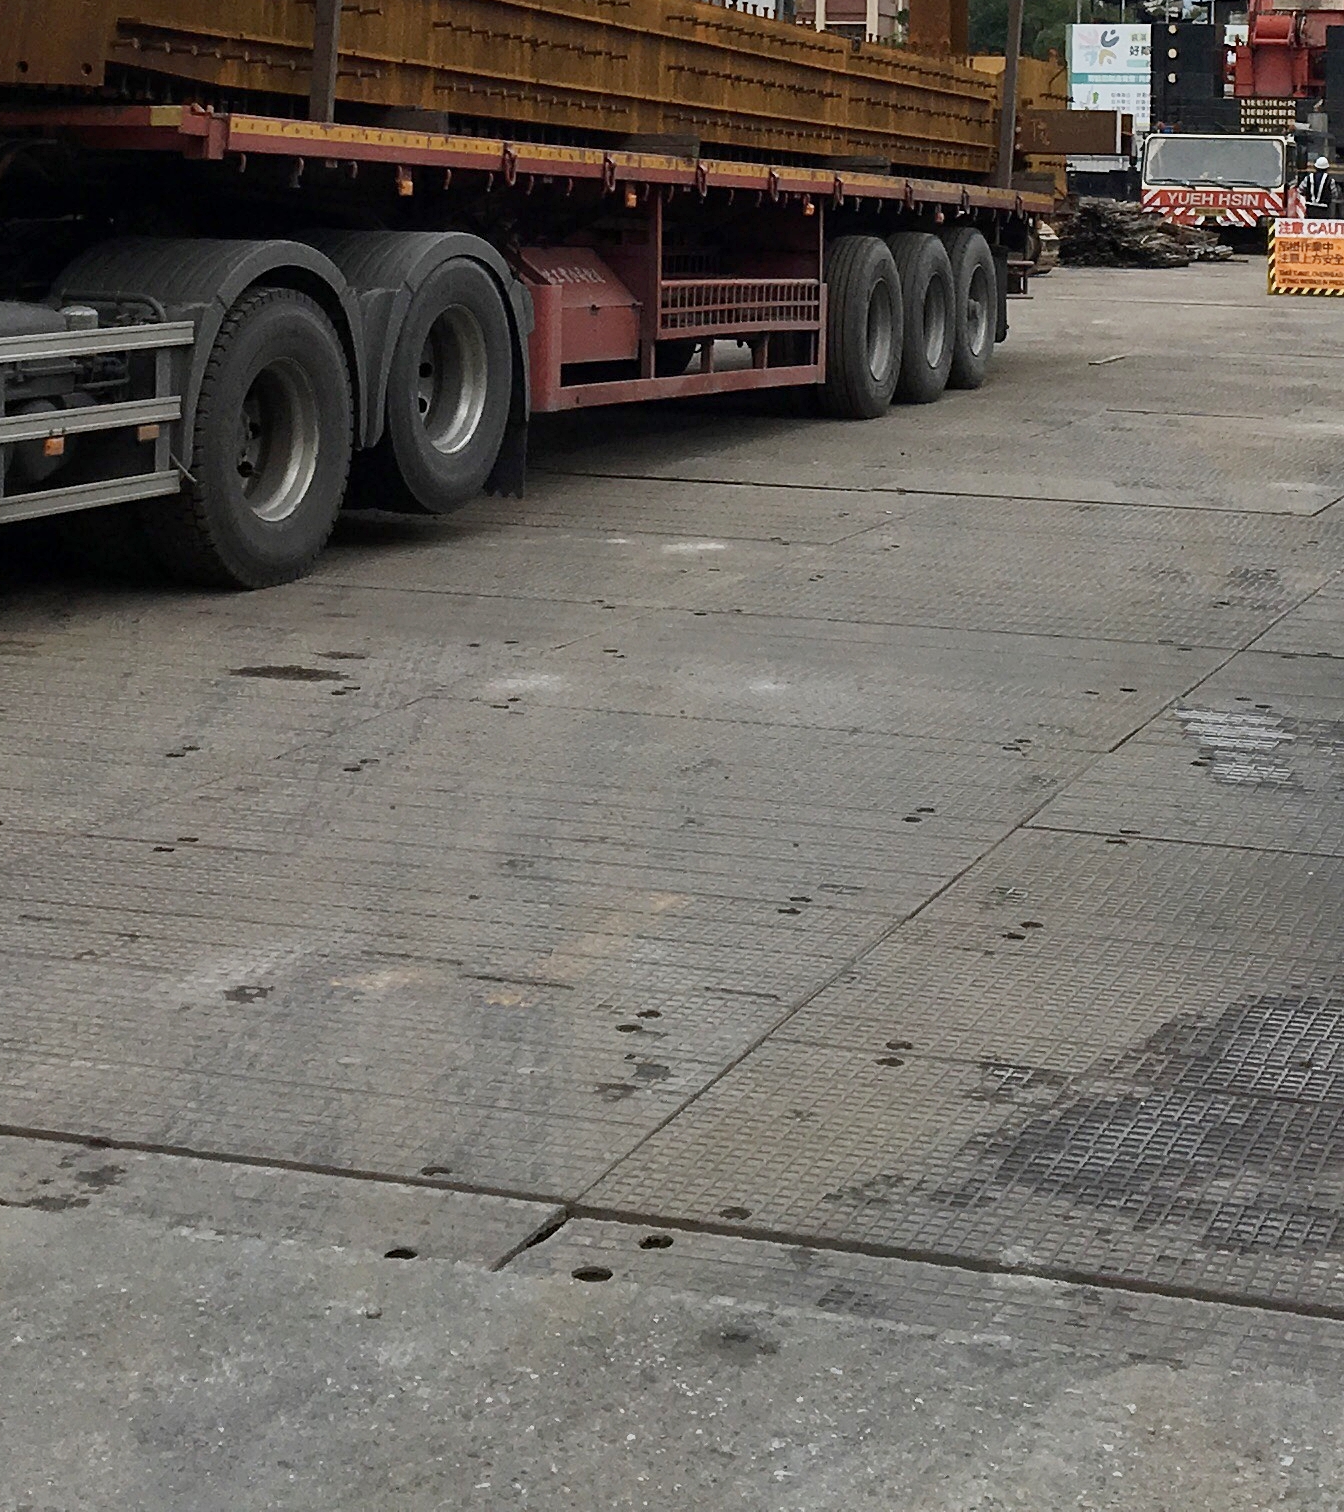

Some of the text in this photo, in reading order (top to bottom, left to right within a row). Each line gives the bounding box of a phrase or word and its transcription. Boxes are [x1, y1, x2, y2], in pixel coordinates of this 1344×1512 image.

[1167, 192, 1260, 206] YUEH HSIN
[1278, 221, 1304, 234] 注意
